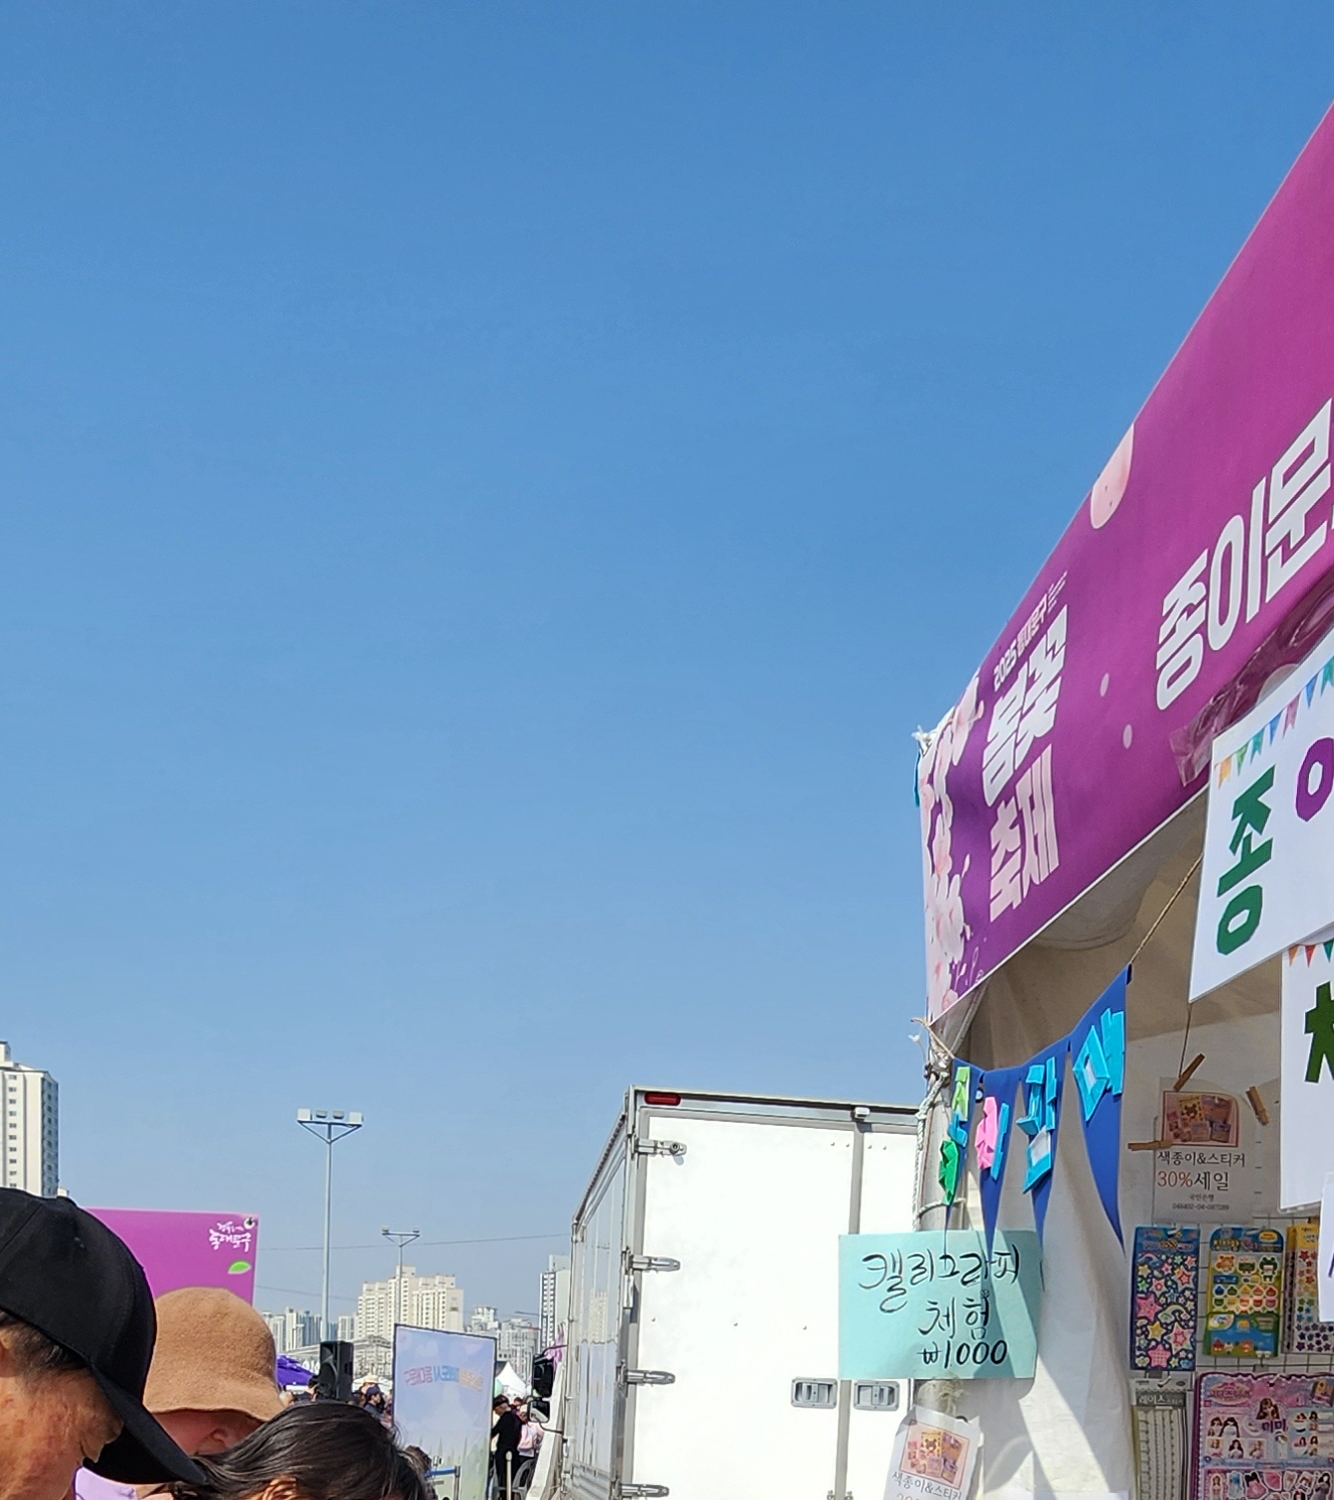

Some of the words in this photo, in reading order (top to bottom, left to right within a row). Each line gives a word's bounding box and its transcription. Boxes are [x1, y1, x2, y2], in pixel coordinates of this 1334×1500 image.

[982, 604, 1067, 807] 봄꽃
[989, 743, 1059, 922] 축제
[1157, 1152, 1245, 1167] 색종이&스티커
[1157, 1171, 1229, 1191] 30%세일
[858, 1243, 1020, 1313] 캘리그라피
[918, 1290, 990, 1340] 체험
